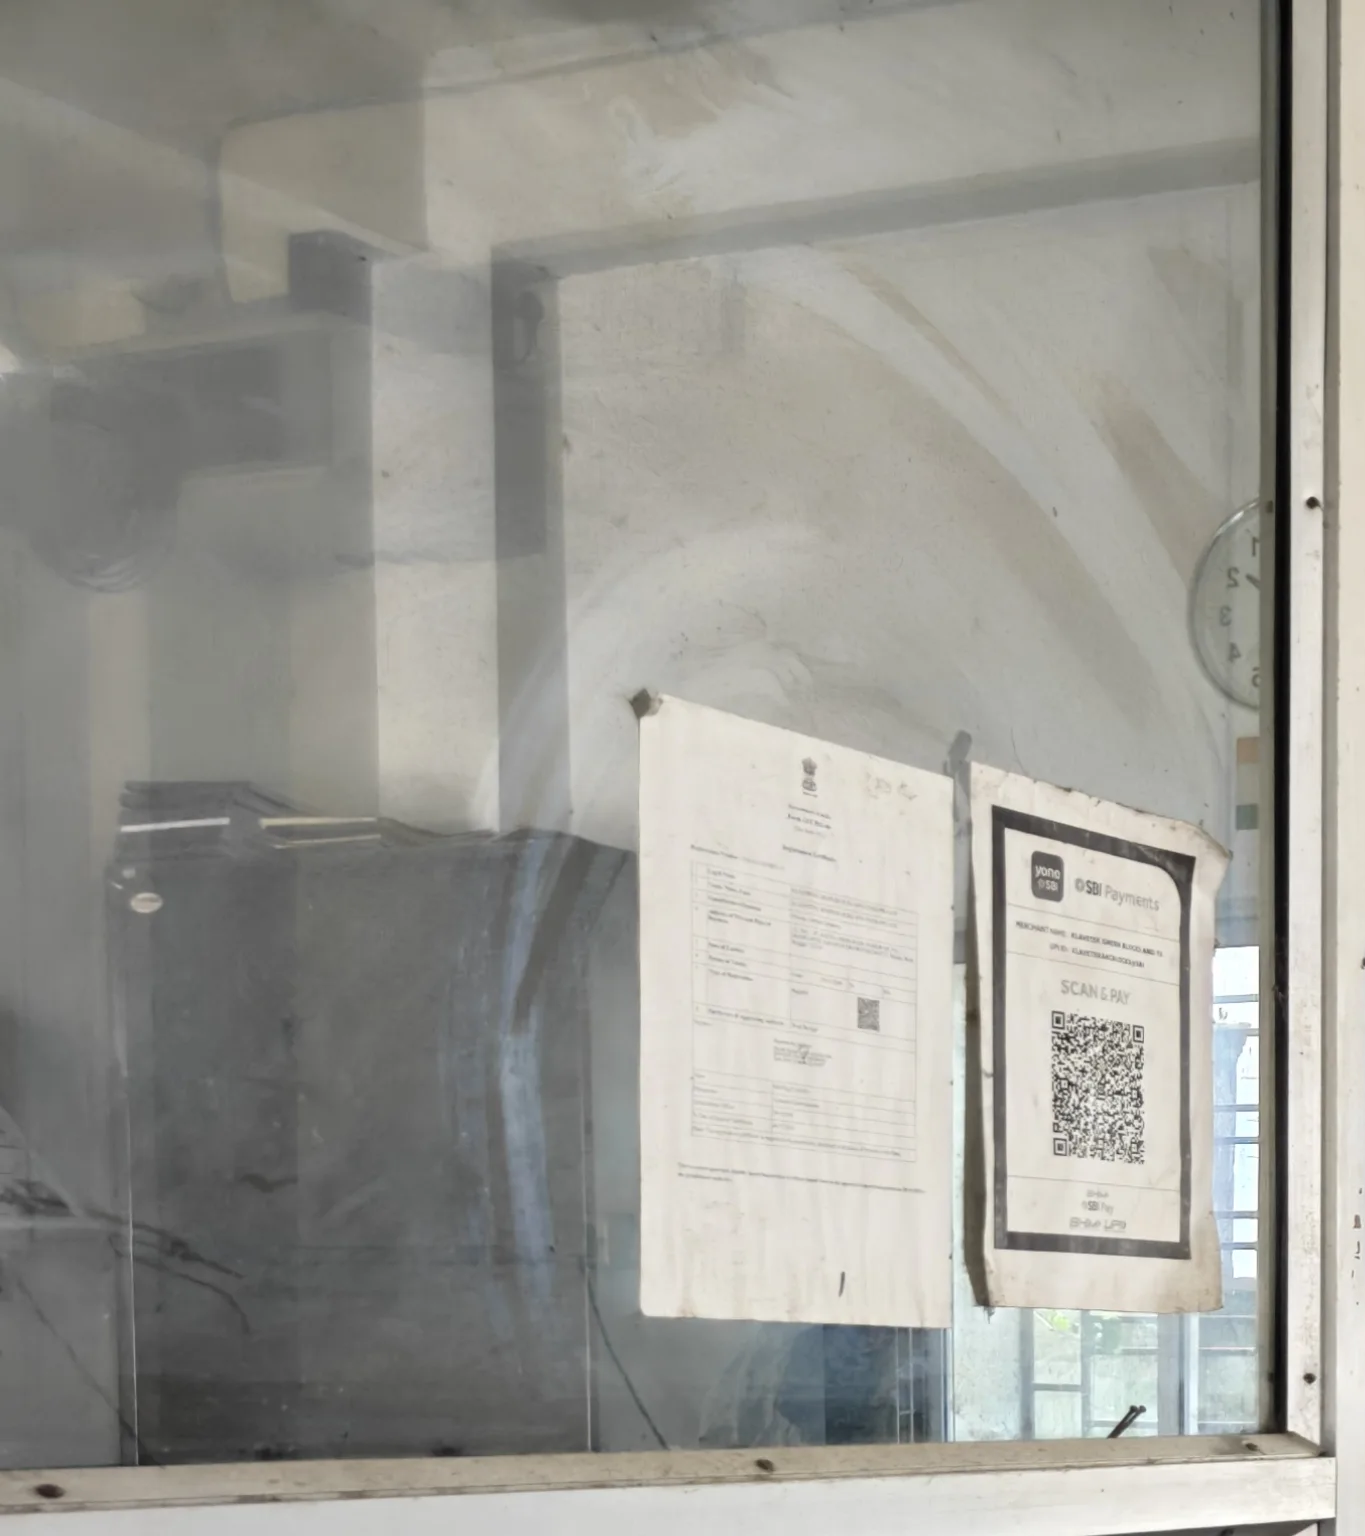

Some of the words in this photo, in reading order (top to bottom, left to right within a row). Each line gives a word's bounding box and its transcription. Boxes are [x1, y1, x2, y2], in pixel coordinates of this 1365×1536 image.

[1034, 865, 1061, 880] yono
[1045, 880, 1058, 892] SBI
[1085, 879, 1102, 896] SBI
[1105, 885, 1160, 911] Payments
[1061, 979, 1098, 1000] SCAN
[1100, 986, 1109, 1001] &
[1110, 988, 1131, 1005] PAY
